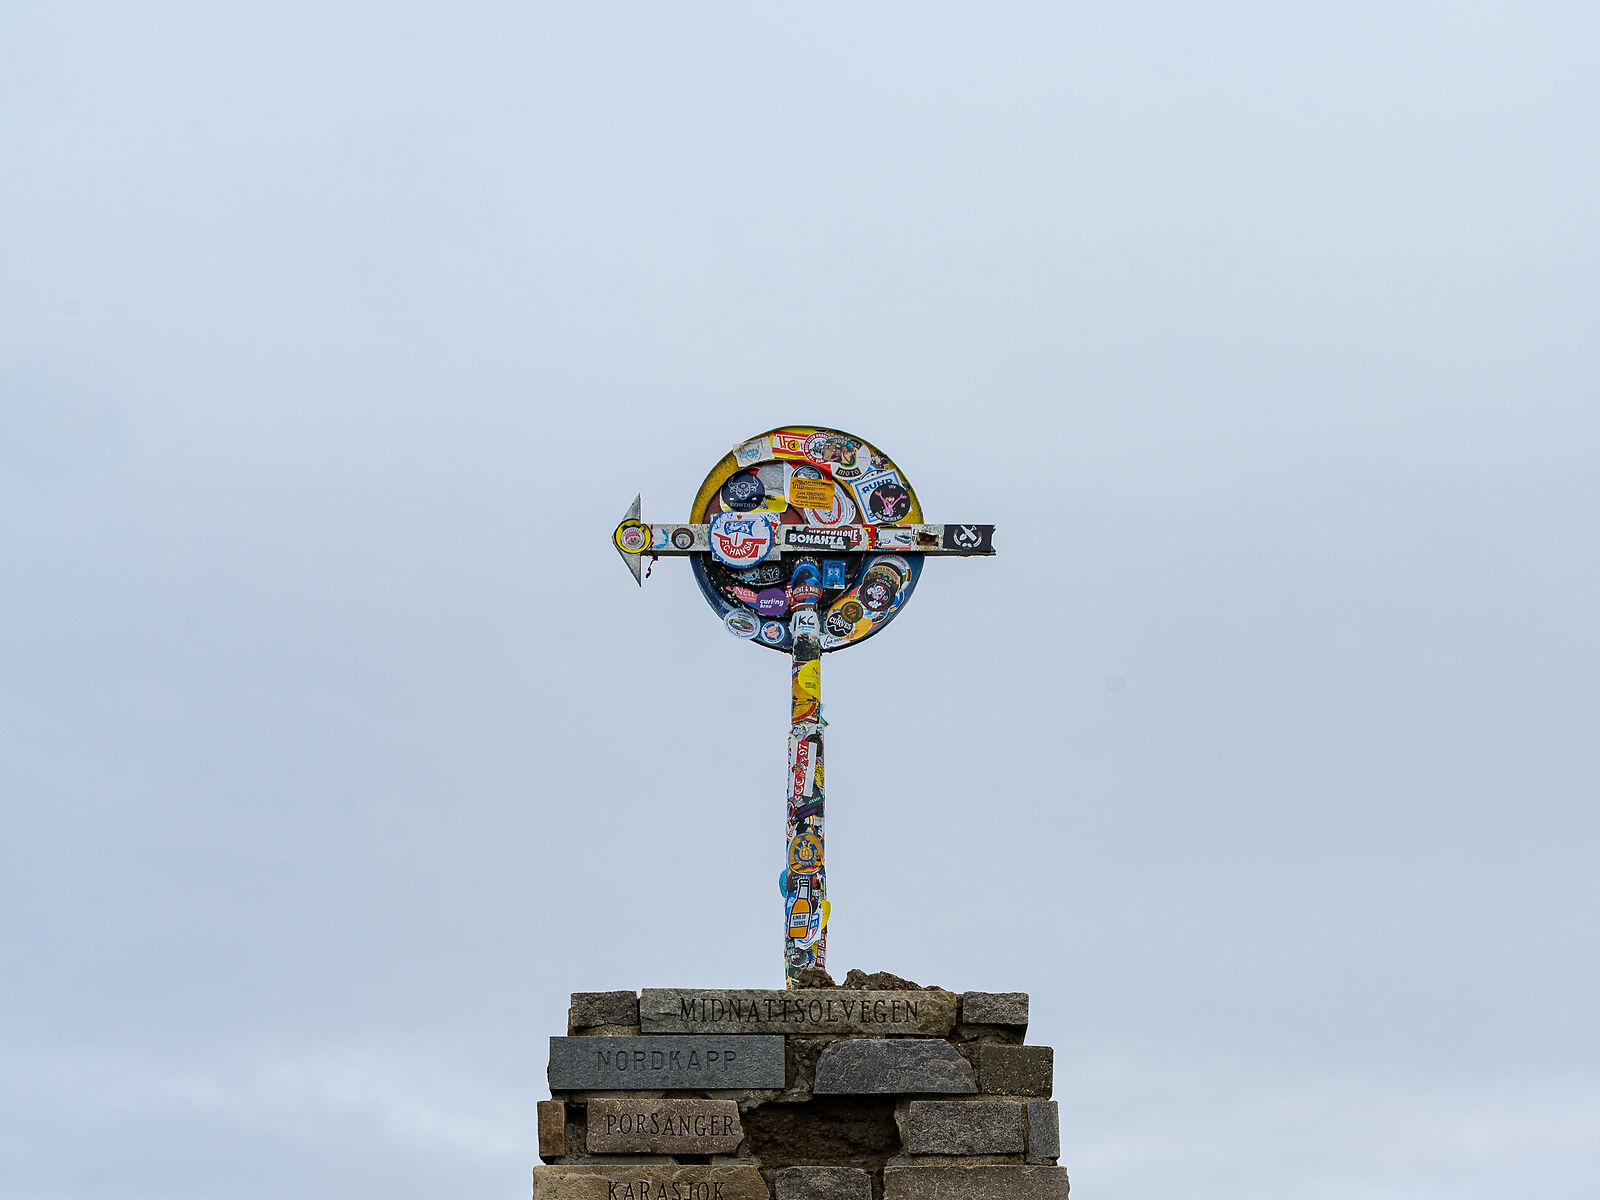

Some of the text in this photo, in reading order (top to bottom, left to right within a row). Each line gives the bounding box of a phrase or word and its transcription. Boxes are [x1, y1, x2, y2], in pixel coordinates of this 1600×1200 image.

[789, 533, 844, 546] BONANZA
[679, 998, 918, 1023] MIDNATTSOLVEGEN
[597, 1050, 737, 1072] NORDKAPP
[605, 1113, 736, 1137] PORSANGER
